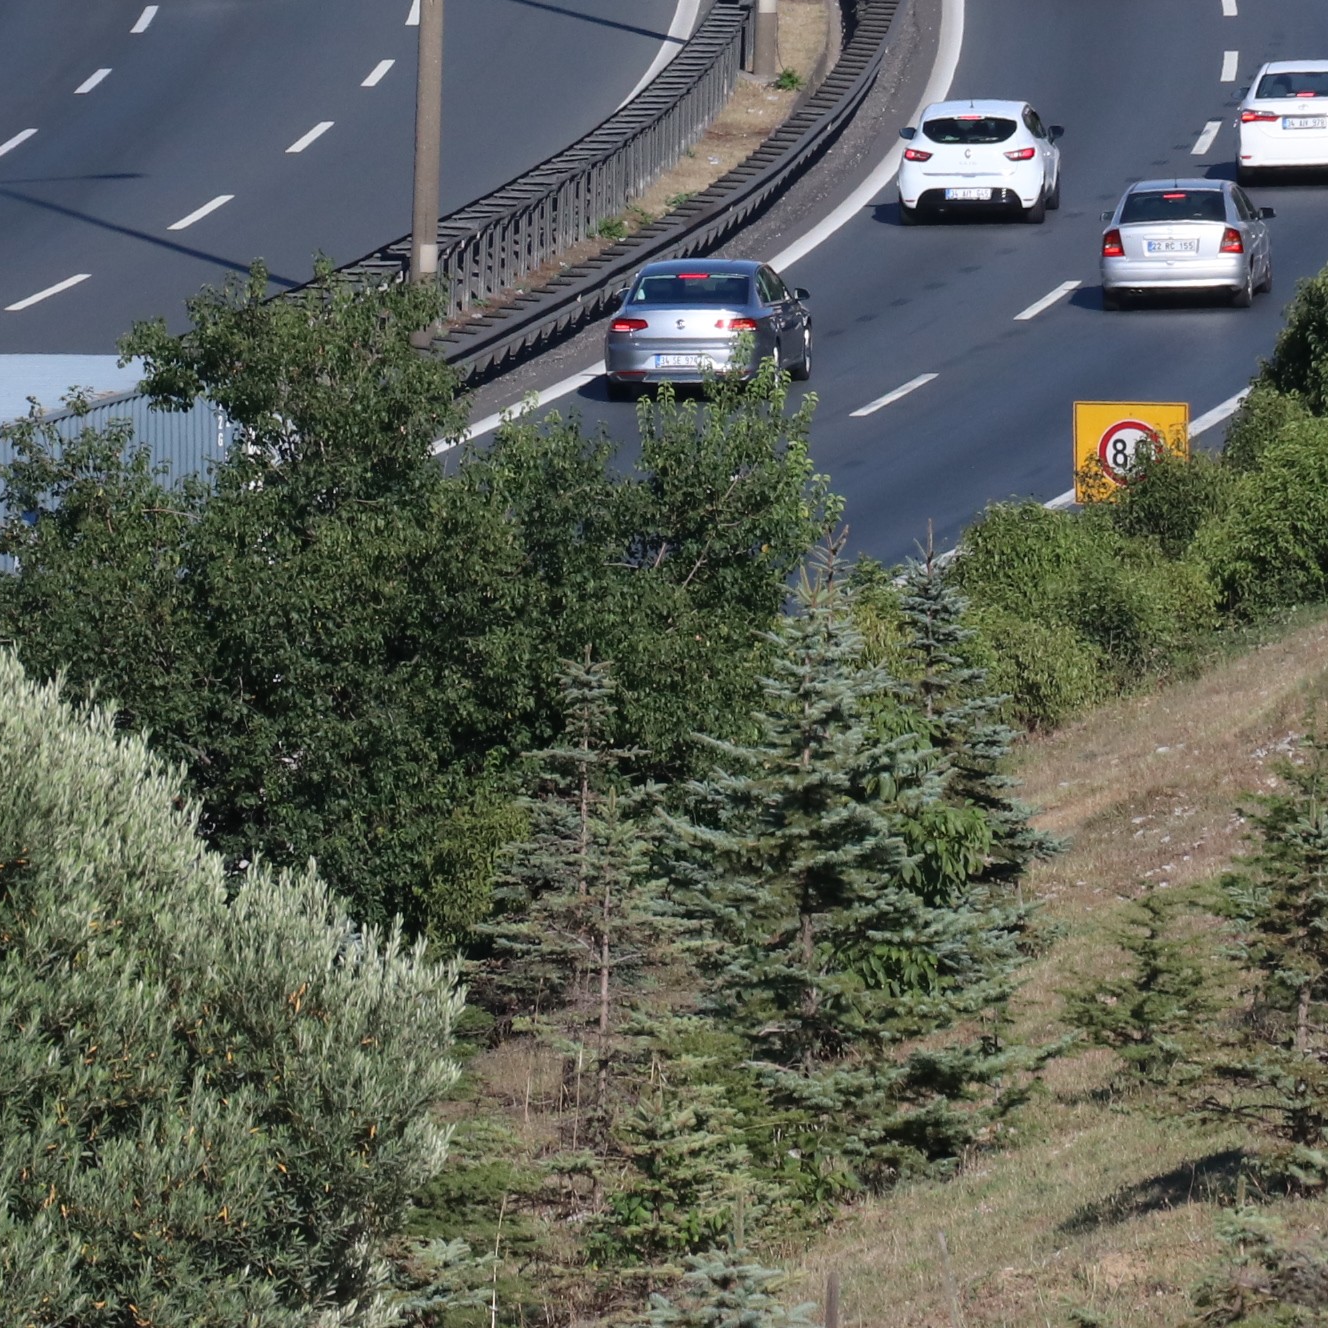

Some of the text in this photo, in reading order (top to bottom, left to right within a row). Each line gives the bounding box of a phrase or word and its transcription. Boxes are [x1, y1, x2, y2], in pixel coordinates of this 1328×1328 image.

[1152, 242, 1194, 251] 22 RC 155
